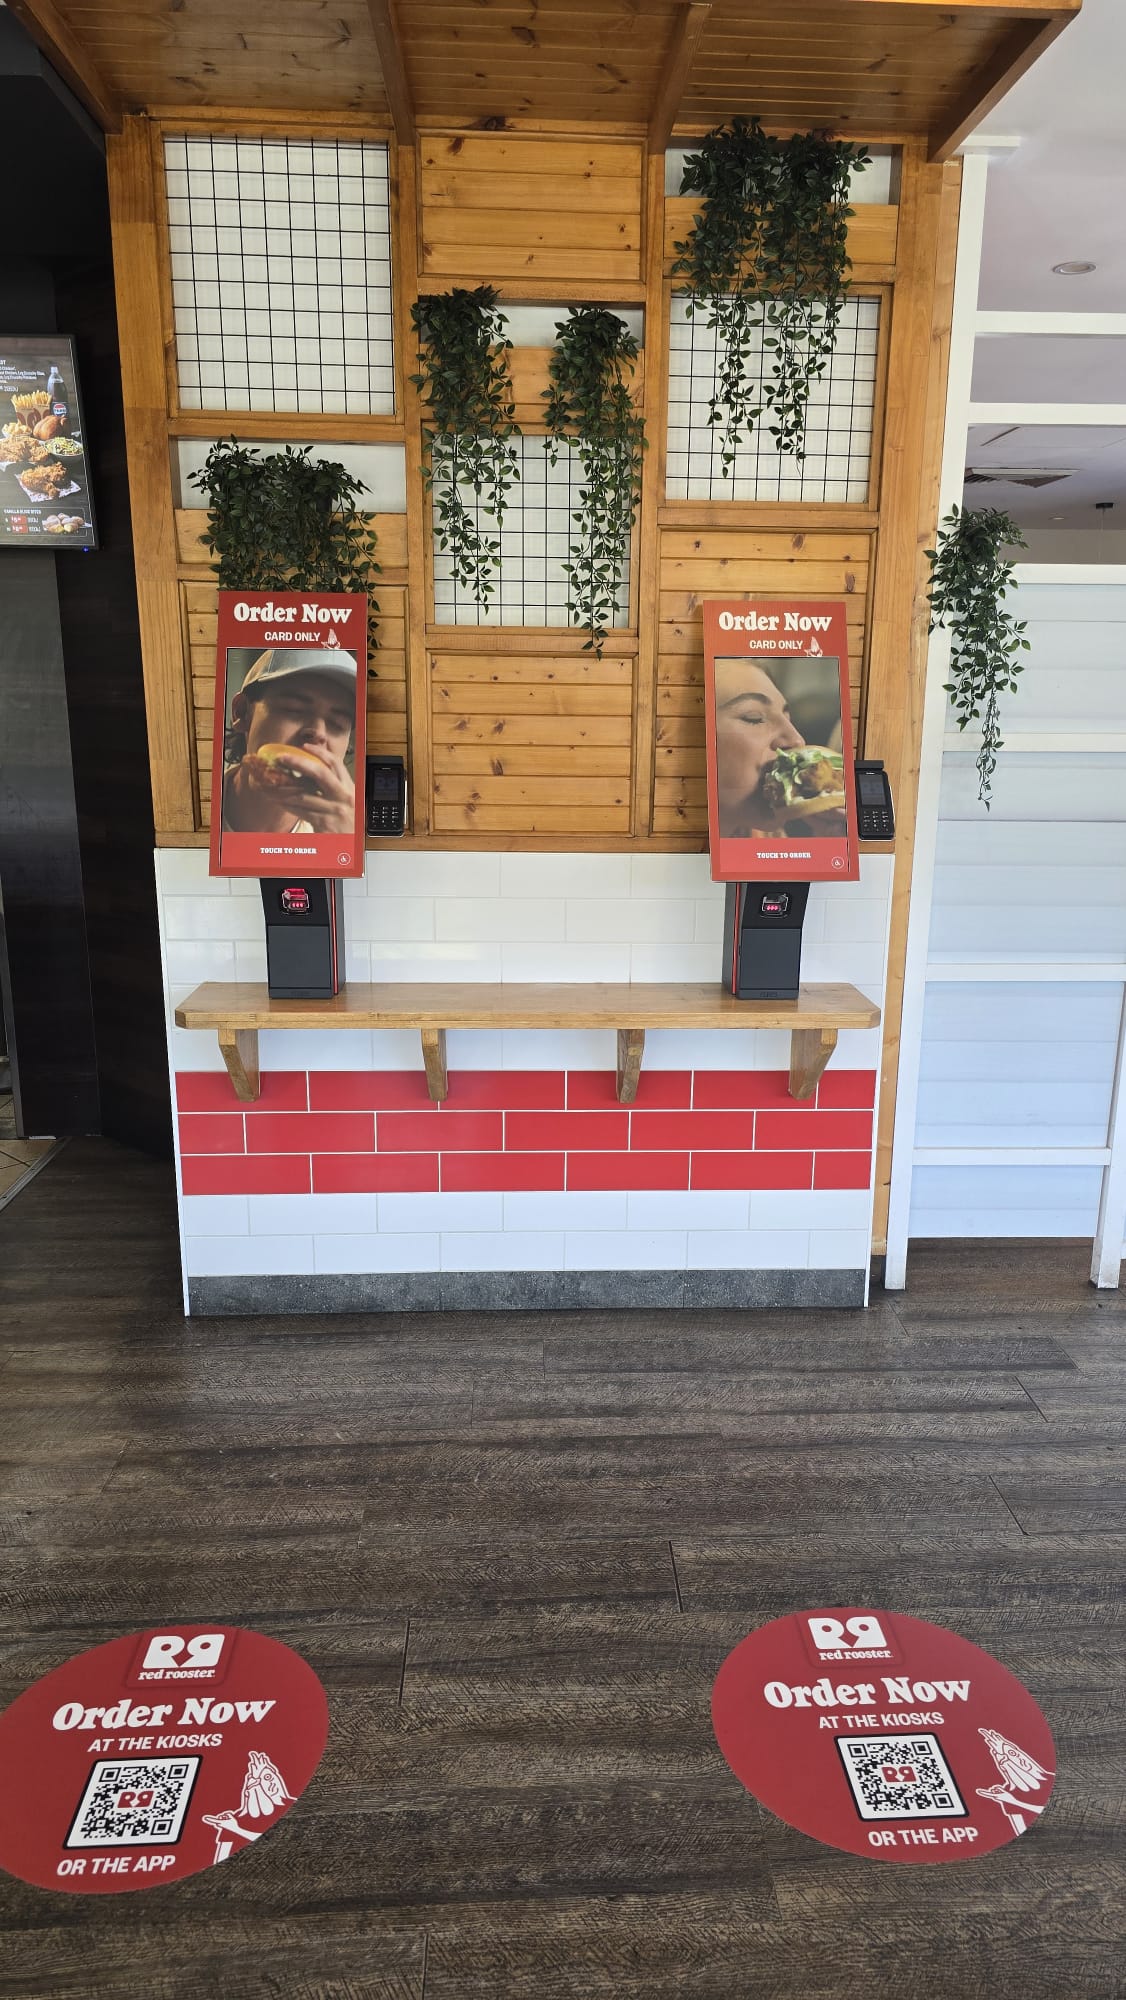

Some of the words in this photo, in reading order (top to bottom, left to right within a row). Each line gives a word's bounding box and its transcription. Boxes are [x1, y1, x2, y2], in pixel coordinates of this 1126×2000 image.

[233, 601, 298, 623] Order
[301, 603, 353, 624] Now
[718, 610, 780, 631] Order
[783, 612, 833, 632] Now
[264, 631, 293, 642] CARD
[294, 631, 321, 642] ONLY
[749, 639, 777, 650] CARD
[778, 640, 804, 650] ONLY
[260, 847, 283, 855] TOUCH
[283, 847, 293, 855] TO
[294, 847, 317, 855] ORDER
[756, 852, 779, 860] TOUCH
[779, 852, 789, 860] TO
[789, 852, 812, 860] ORDER
[819, 1649, 844, 1661] red
[844, 1649, 892, 1661] rooster
[137, 1668, 165, 1681] red
[165, 1668, 215, 1680] rooster
[763, 1678, 876, 1709] Order
[880, 1676, 971, 1704] Now
[52, 1699, 173, 1731] Order
[177, 1697, 277, 1725] Now
[819, 1715, 840, 1729] AT
[842, 1714, 880, 1728] THE
[880, 1711, 945, 1727] KIOSKS
[87, 1738, 115, 1753] AT
[118, 1736, 155, 1751] THE
[155, 1733, 223, 1750] KIOSKS
[868, 1830, 897, 1847] OR
[897, 1828, 940, 1846] THE
[942, 1826, 979, 1845] APP
[56, 1858, 88, 1876] OR
[91, 1856, 131, 1875] THE
[133, 1854, 176, 1873] APP
